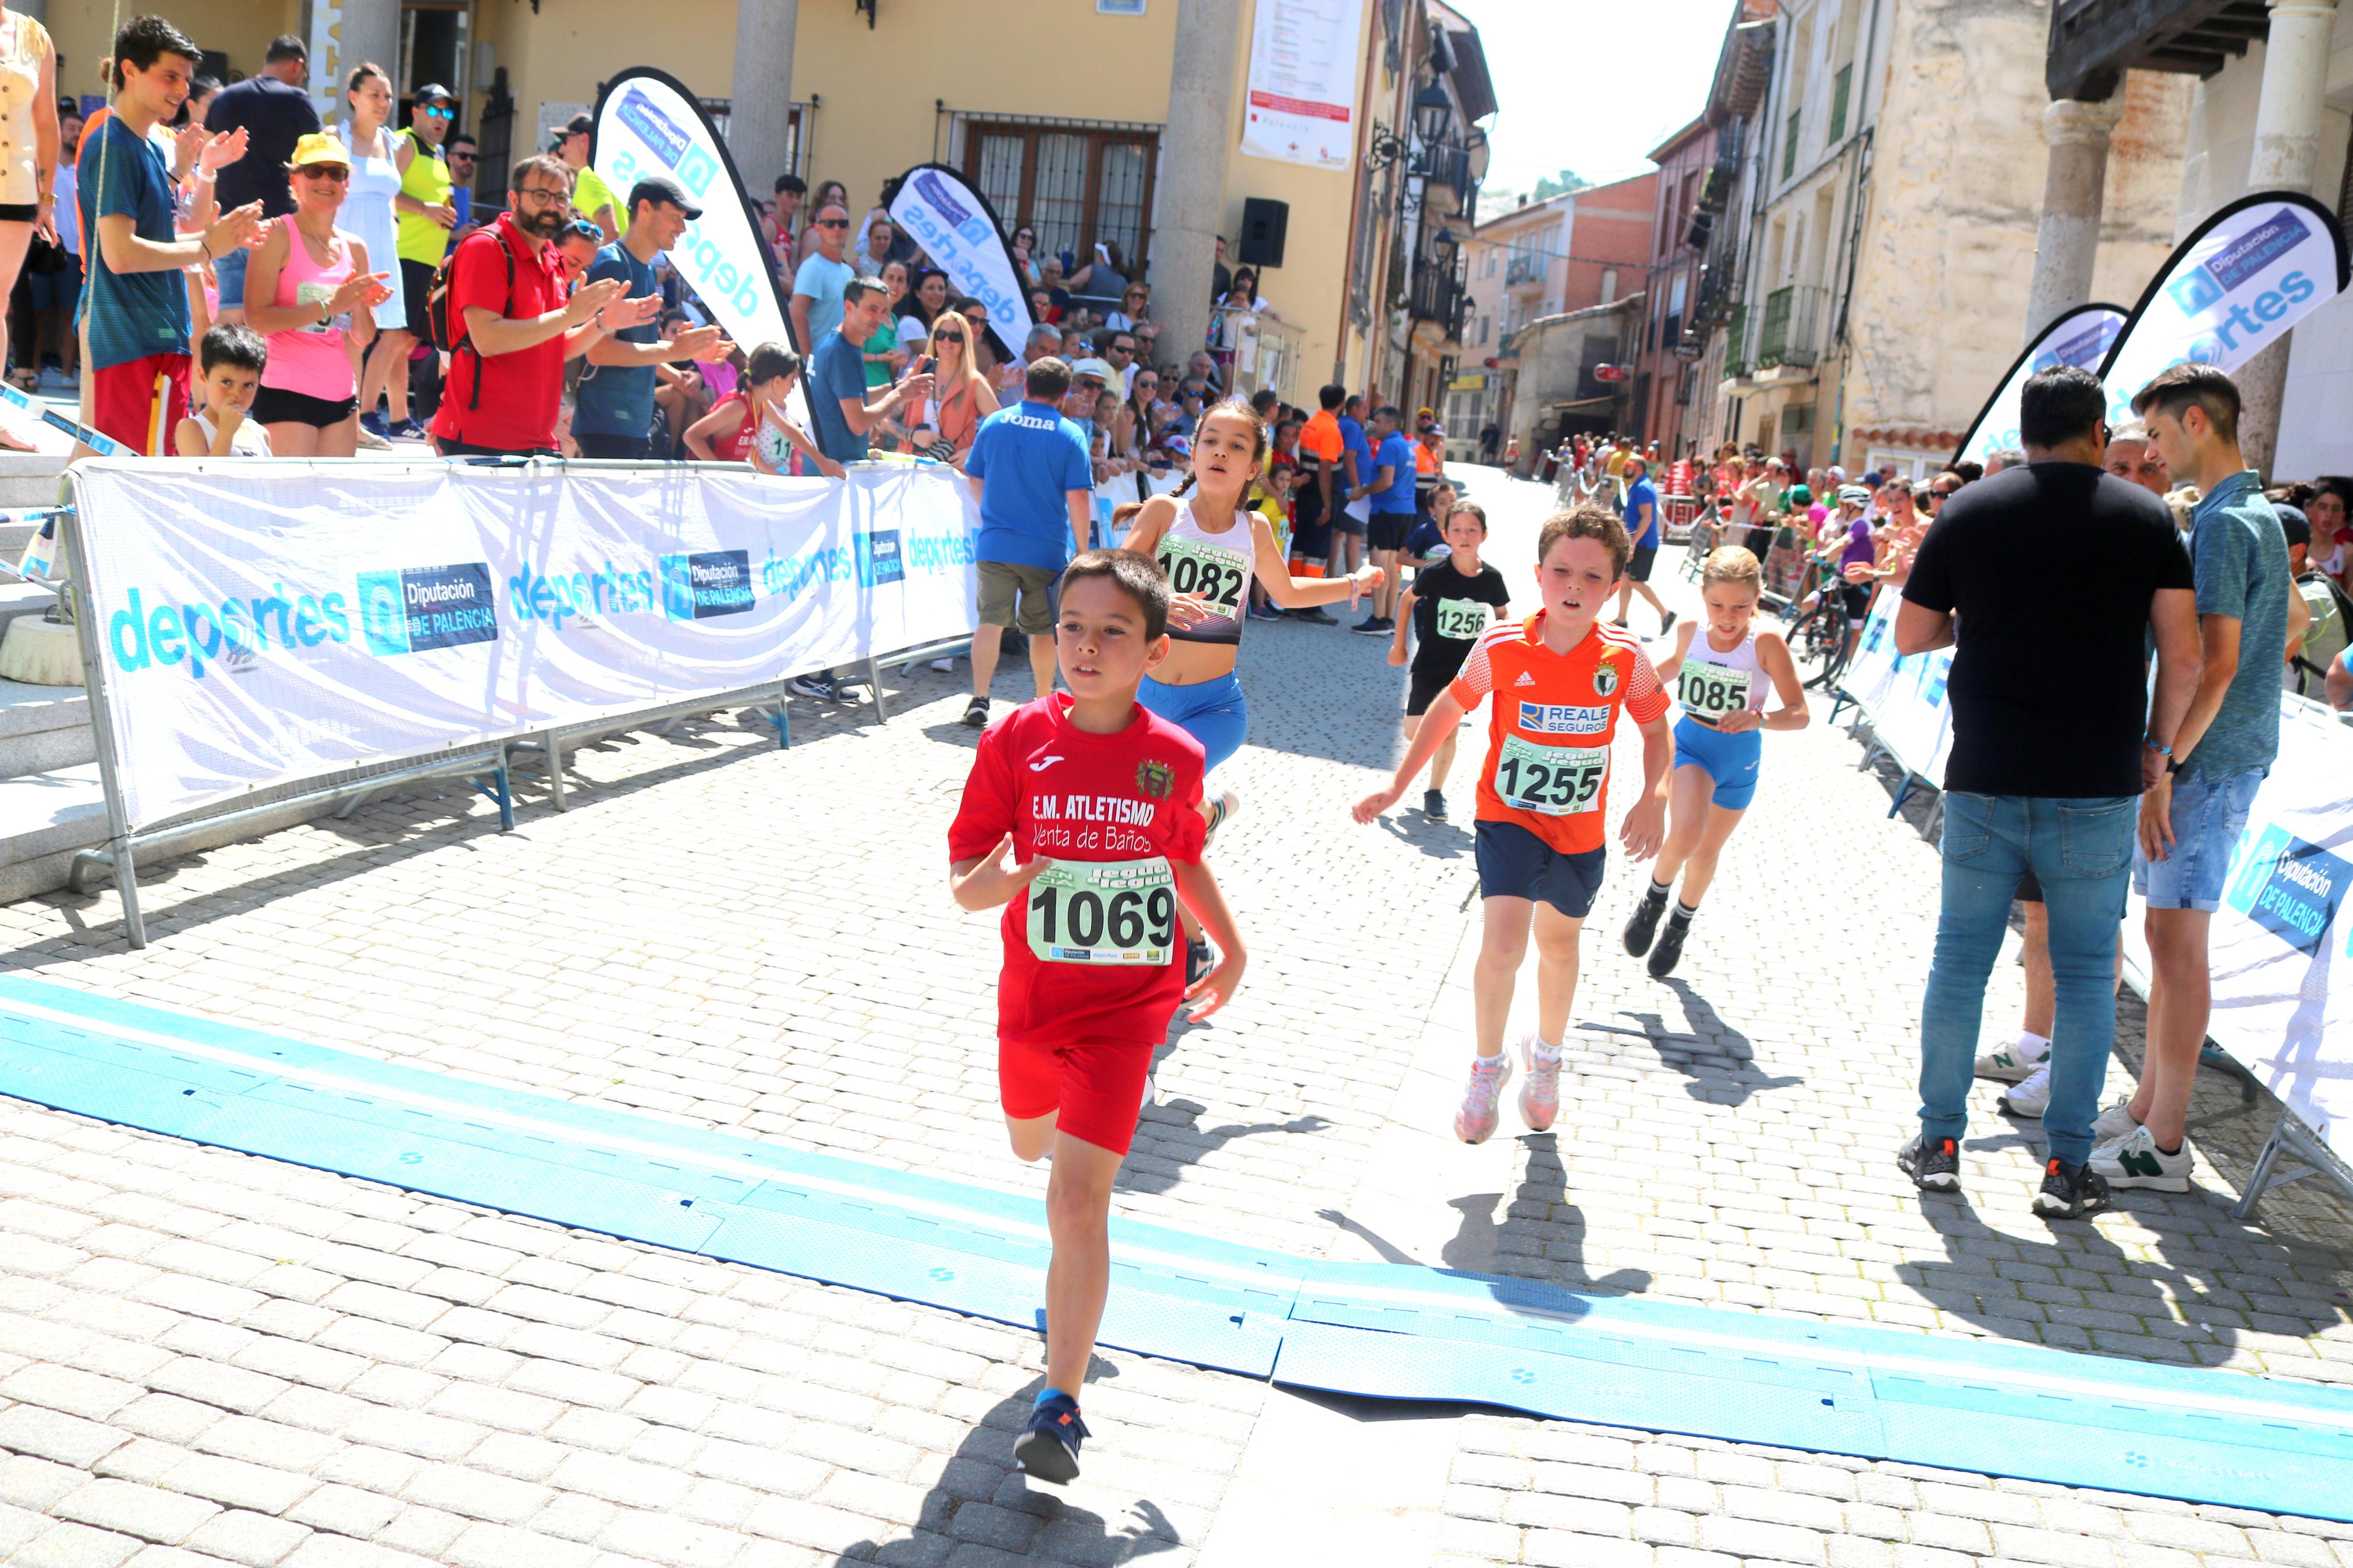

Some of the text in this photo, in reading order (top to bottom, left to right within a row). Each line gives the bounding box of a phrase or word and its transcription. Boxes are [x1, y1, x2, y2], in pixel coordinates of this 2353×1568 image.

[2211, 223, 2279, 273] Diputación
[2221, 225, 2304, 286] DE PALENCIA
[908, 527, 976, 575] deportes
[1159, 545, 1184, 555] CIA
[1195, 544, 1244, 563] legua
[692, 562, 738, 585] Diputación
[1158, 552, 1243, 607] 1082
[407, 578, 475, 607] Diputación
[509, 560, 654, 631] deportes
[695, 586, 755, 606] DE PALENCIA
[109, 582, 350, 679] deportes
[411, 607, 494, 637] DE PALENCIA
[1439, 609, 1485, 634] 1256
[1678, 672, 1747, 711] 1085
[1548, 721, 1607, 733] SEGUROS
[1549, 706, 1609, 721] REALE
[1506, 749, 1532, 762] CIA
[1546, 751, 1601, 760] legua
[1549, 757, 1605, 767] legua
[1501, 758, 1603, 805] 1255
[1032, 795, 1155, 827] E.M. ATLETISMO
[1032, 822, 1151, 852] Venta de Baños
[1036, 874, 1074, 888] CIA
[1092, 865, 1167, 877] legua
[1100, 874, 1173, 889] legua
[2278, 850, 2331, 898] Diputación
[1032, 886, 1175, 948] 1069
[2258, 884, 2327, 937] DE PALENCIA
